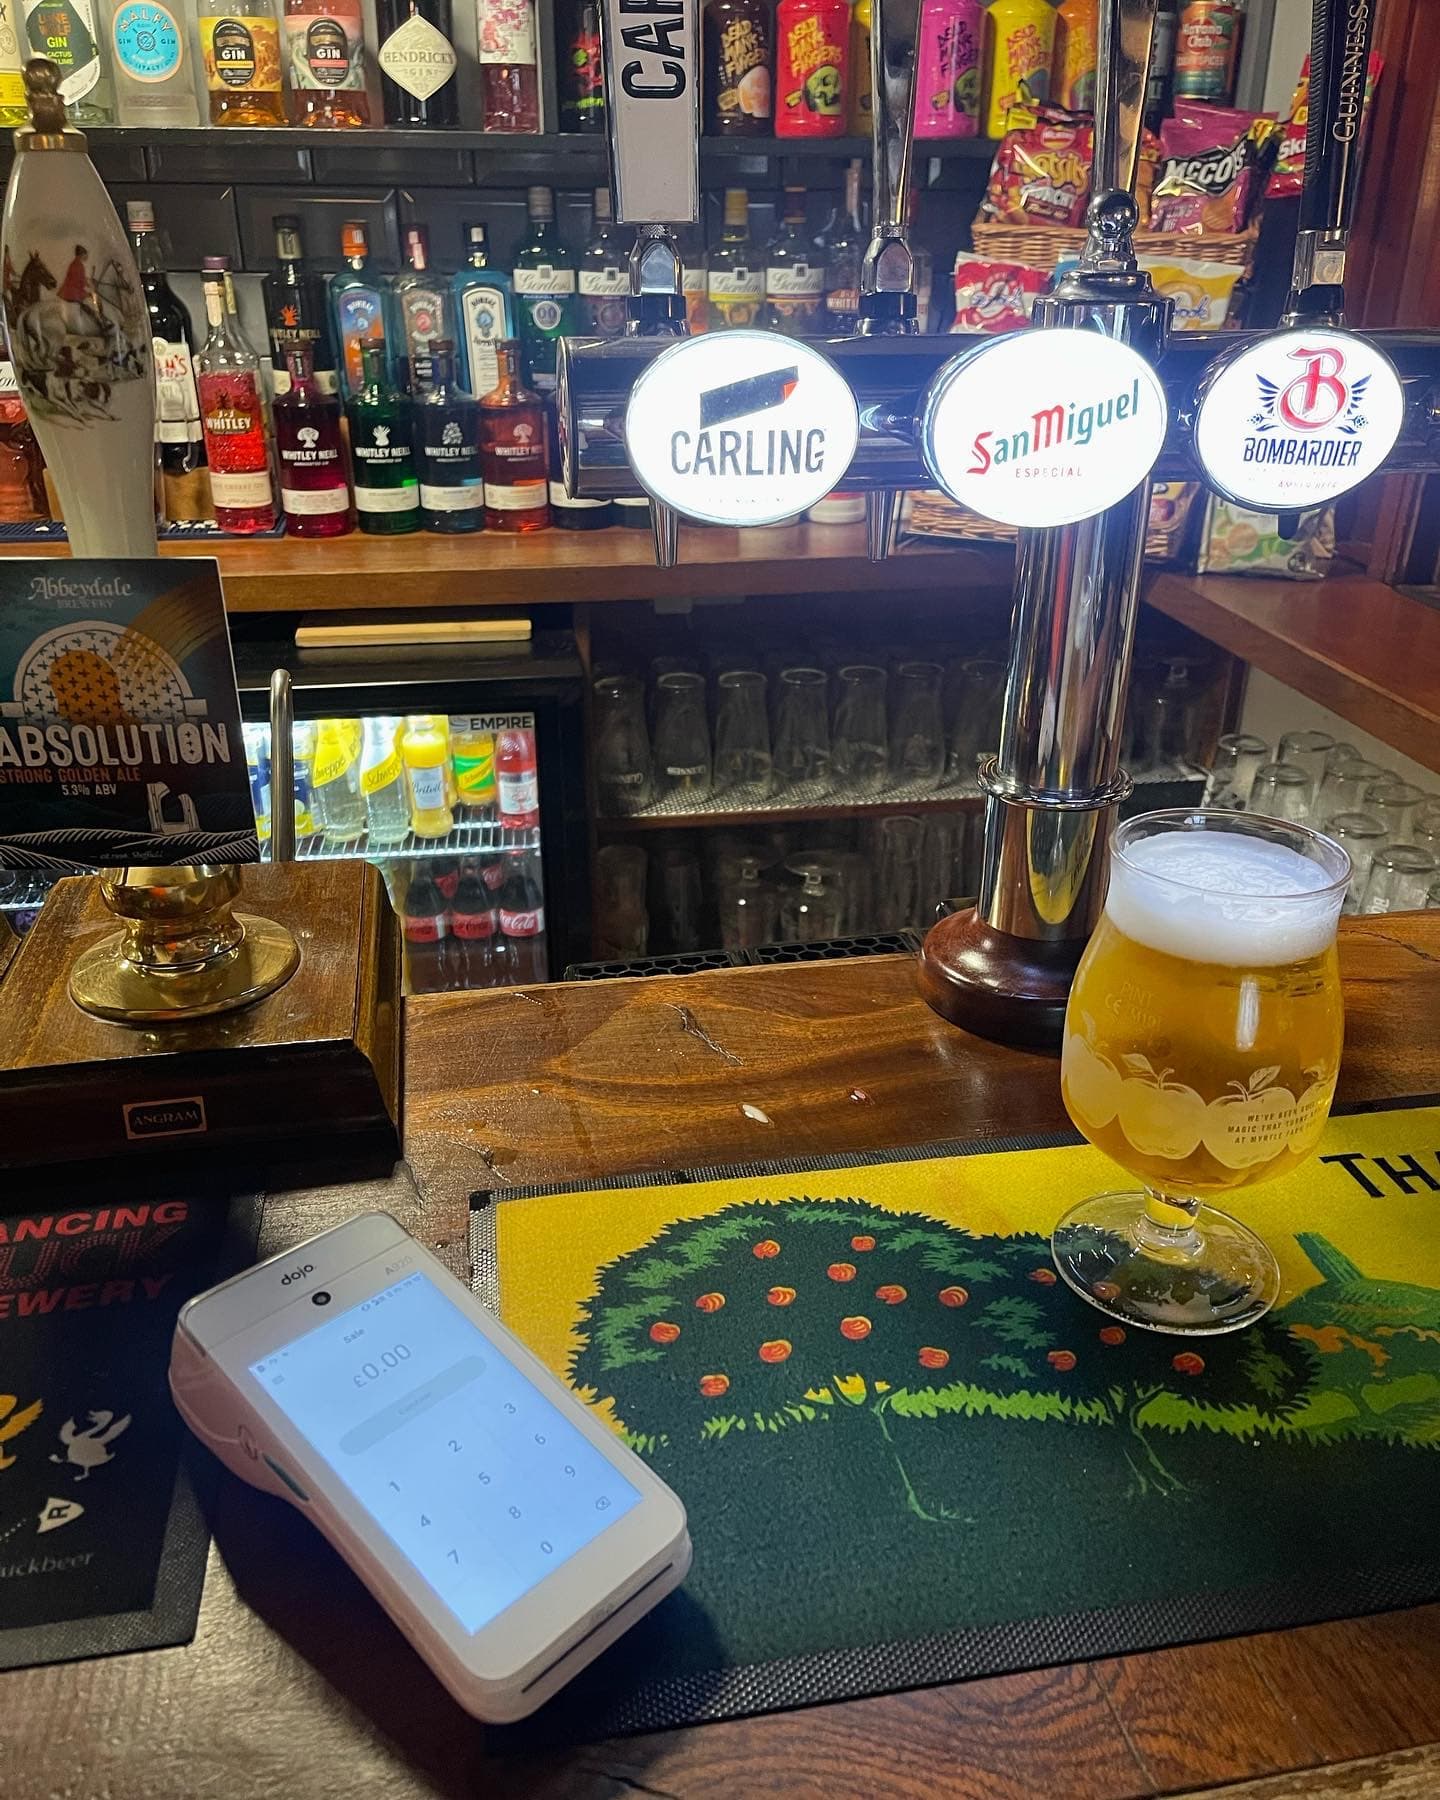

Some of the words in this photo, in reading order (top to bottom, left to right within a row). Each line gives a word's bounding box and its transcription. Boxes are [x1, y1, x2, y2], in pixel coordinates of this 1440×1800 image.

[47, 37, 67, 48] GIN
[221, 49, 246, 60] GIN
[316, 48, 341, 59] GIN
[1332, 3, 1369, 142] GUINNESS
[206, 417, 252, 430] WHITLEY
[281, 449, 318, 462] WHITLEY
[318, 449, 339, 459] NEILL
[354, 447, 391, 458] WHITLEY
[424, 446, 460, 457] WHITLEY
[671, 428, 825, 475] CARLING
[1242, 437, 1362, 466] BOMBARDIER
[1015, 466, 1083, 478] ESPECIAL
[28, 576, 134, 600] Abbeydale
[57, 598, 114, 609] BREWERY
[470, 718, 533, 731] EMPIRE
[0, 722, 231, 766] ABSOLUTION
[0, 768, 53, 784] STRONG
[58, 768, 111, 783] GOLDEN
[116, 767, 142, 782] ALE
[62, 784, 90, 796] 5.3%
[95, 783, 117, 795] ABV
[134, 1110, 199, 1128] ANGRAM
[1247, 1113, 1275, 1122] WE'VE
[1227, 1125, 1257, 1133] MAGIC
[1261, 1122, 1282, 1132] THAT
[1234, 1136, 1246, 1144] AT
[1319, 1152, 1440, 1199] TH
[0, 1202, 188, 1243] NCING
[281, 1264, 314, 1286] dojo
[343, 1328, 365, 1344] Sale
[353, 1344, 412, 1388] £0.00
[388, 1480, 401, 1492] 1
[448, 1439, 463, 1452] 2
[503, 1402, 517, 1415] 3
[419, 1514, 432, 1527] 4
[478, 1471, 492, 1485] 5
[534, 1433, 547, 1446] 6
[447, 1549, 460, 1564] 7
[508, 1506, 522, 1520] 8
[563, 1465, 576, 1478] 9
[540, 1541, 554, 1554] 0
